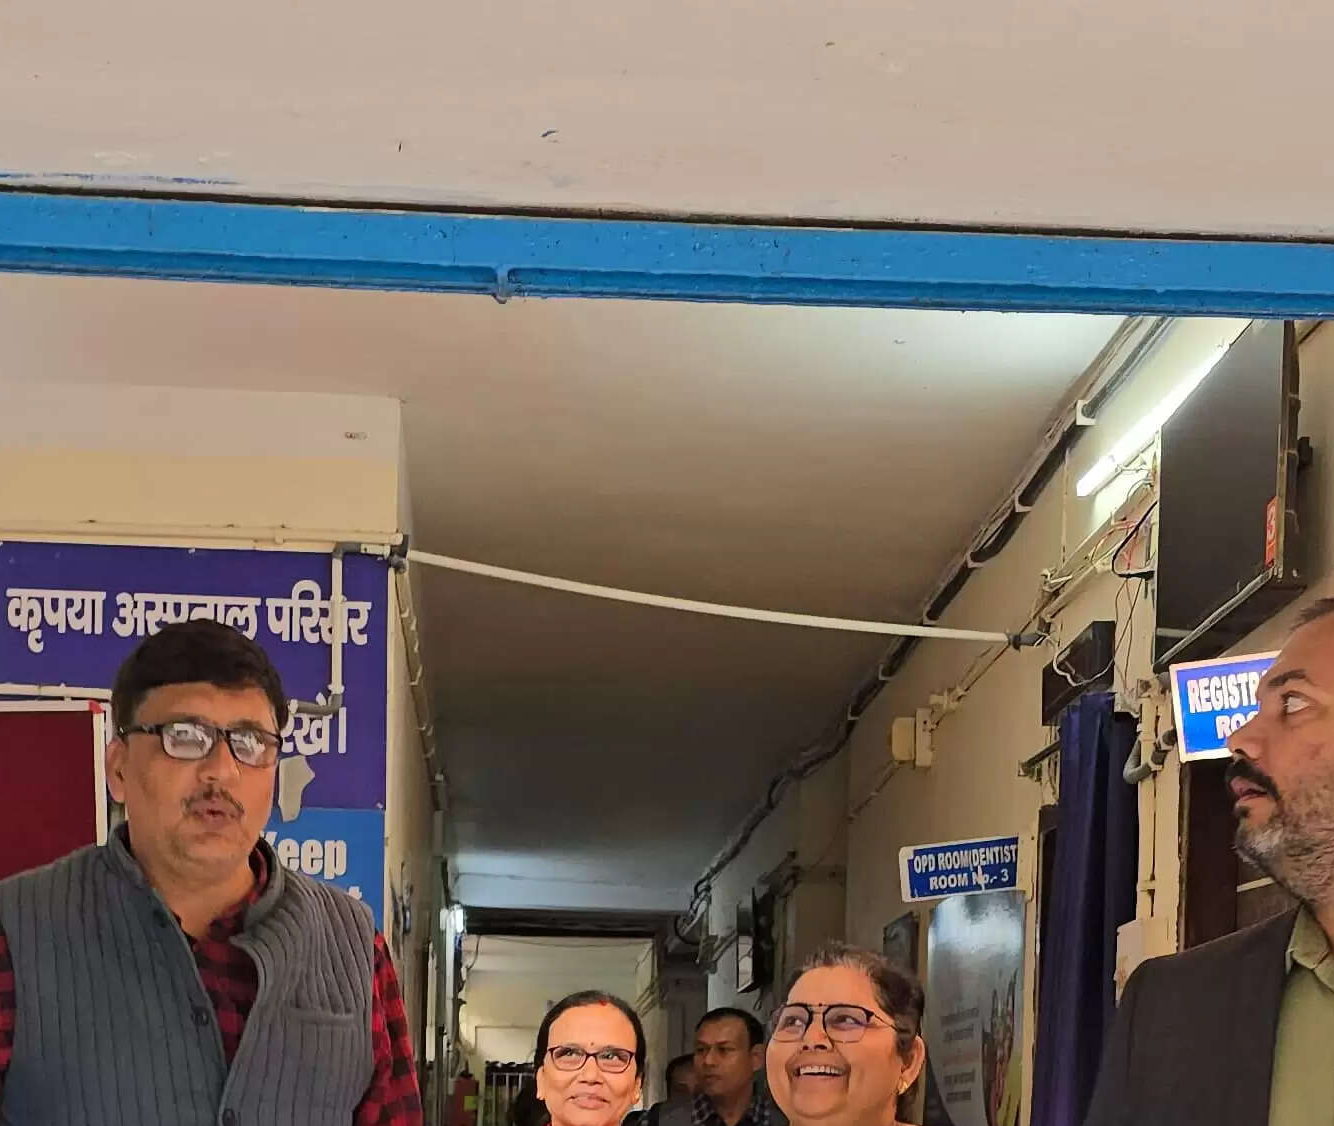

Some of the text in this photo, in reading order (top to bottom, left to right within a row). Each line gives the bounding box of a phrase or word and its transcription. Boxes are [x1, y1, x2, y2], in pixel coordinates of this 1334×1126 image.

[6, 588, 107, 654] कृपया
[1187, 669, 1268, 714] REGISTR
[261, 831, 347, 880] eep
[913, 853, 936, 875] OPD
[929, 872, 968, 891] ROOM
[1000, 867, 1009, 883] 3
